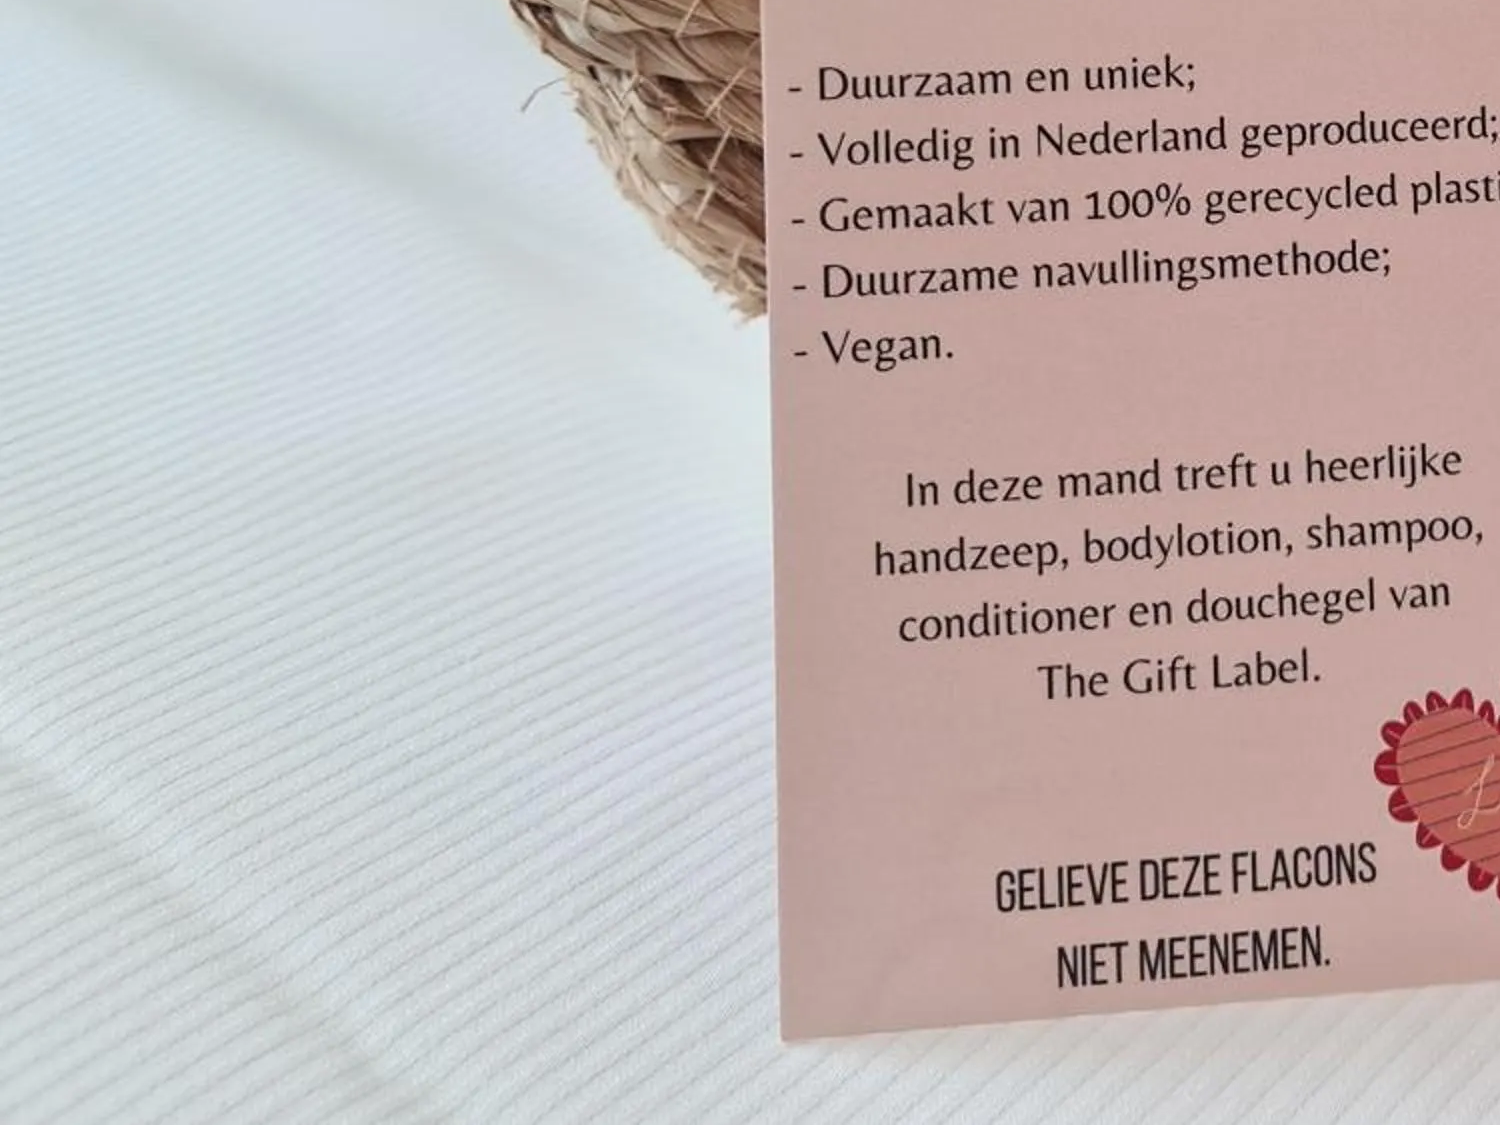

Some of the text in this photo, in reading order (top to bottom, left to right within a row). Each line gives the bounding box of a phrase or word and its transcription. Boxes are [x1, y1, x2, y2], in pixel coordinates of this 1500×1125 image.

[818, 66, 1012, 102] Duurzaam
[1024, 67, 1070, 94] en
[1083, 52, 1196, 93] uniek;
[816, 126, 975, 172] Volledig
[988, 126, 1021, 160] in
[1036, 115, 1228, 158] Nederland
[1240, 104, 1499, 160] geproduceerd;
[818, 191, 995, 233] Gemaakt
[1006, 197, 1070, 225] van
[1084, 182, 1192, 221] 100%
[1204, 172, 1399, 226] gerecycled
[822, 263, 1019, 299] Duurzame
[1032, 238, 1391, 292] navullingsmethode;
[820, 329, 954, 373] Vegan.
[906, 442, 1463, 508] In deze mand treft u heerlijke
[874, 512, 1484, 577] handzeep, bodylotion, shampoo,
[898, 576, 1451, 643] conditioner en douchegel van
[1036, 646, 1321, 700] The Gift Label.
[995, 840, 1378, 914] GELIEVE DEZE FLACONS
[1056, 924, 1331, 990] NIET MEENEMEN.
